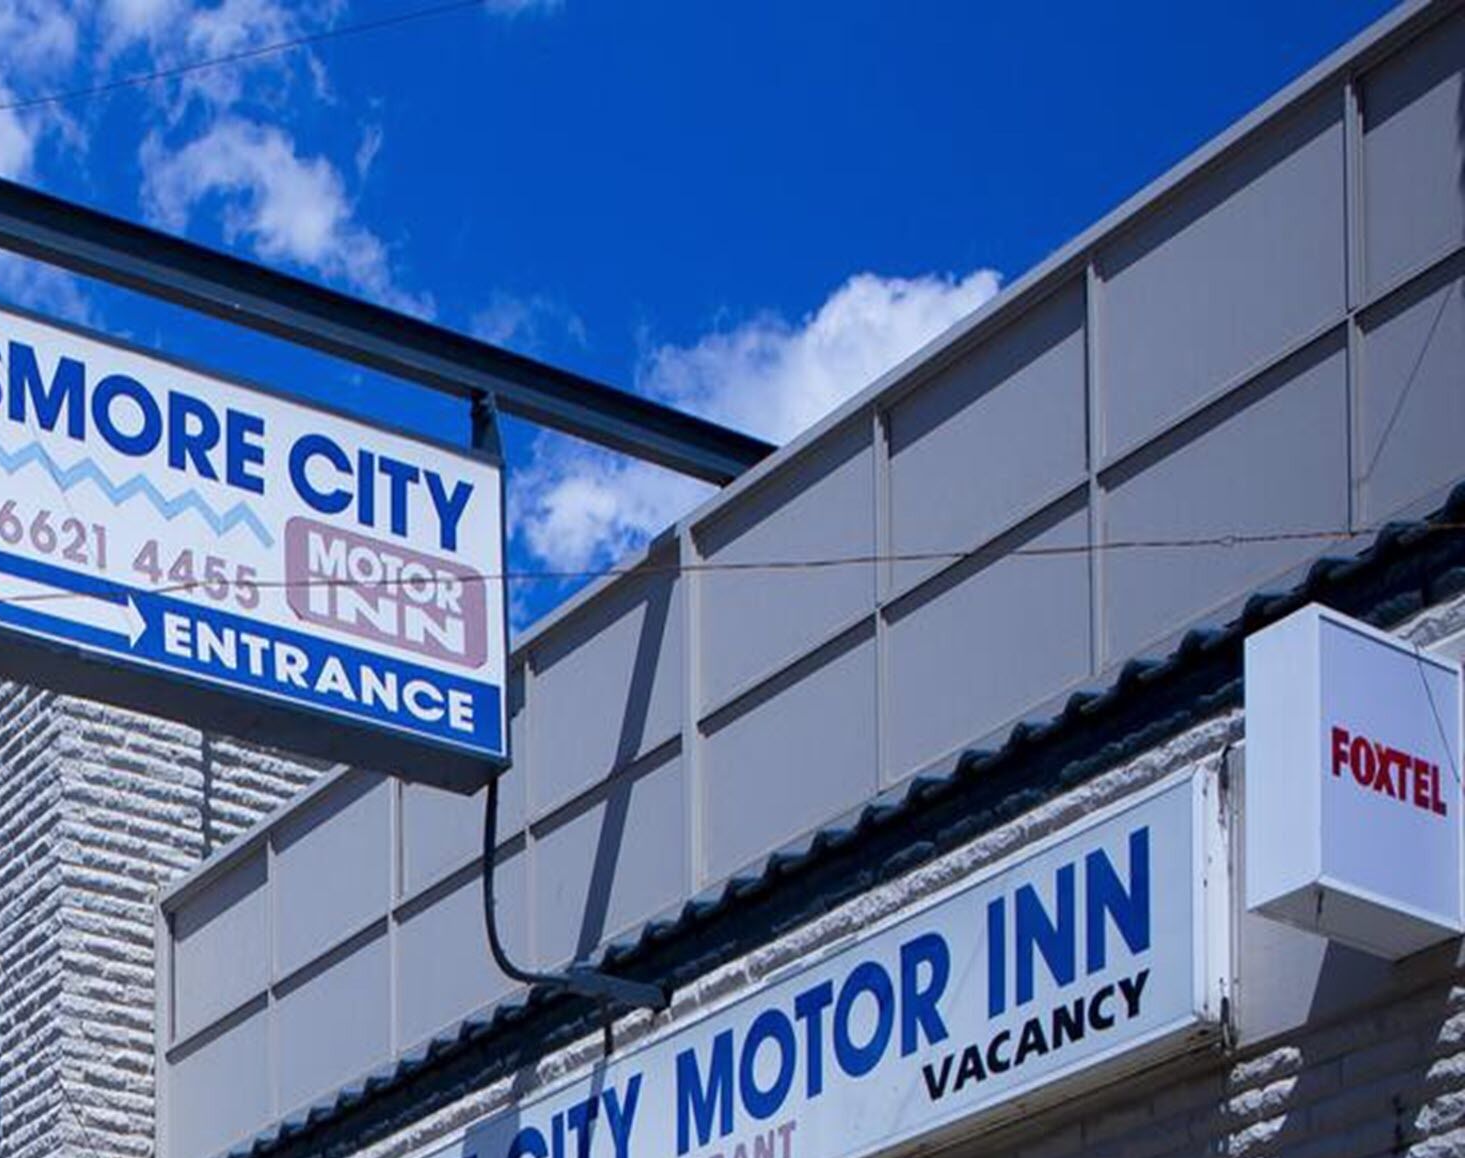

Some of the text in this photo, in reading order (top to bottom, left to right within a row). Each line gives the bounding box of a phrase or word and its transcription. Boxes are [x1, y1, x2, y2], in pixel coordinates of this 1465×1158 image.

[288, 433, 474, 552] CITY
[133, 541, 261, 609] 4455
[307, 532, 464, 612] MOTOR
[307, 573, 466, 656] INN
[163, 615, 475, 733] ENTRANCE
[1331, 726, 1447, 817] FOXTEL
[676, 932, 950, 1157] MOTOR
[987, 826, 1151, 1021] INN
[923, 969, 1151, 1102] VACANCY
